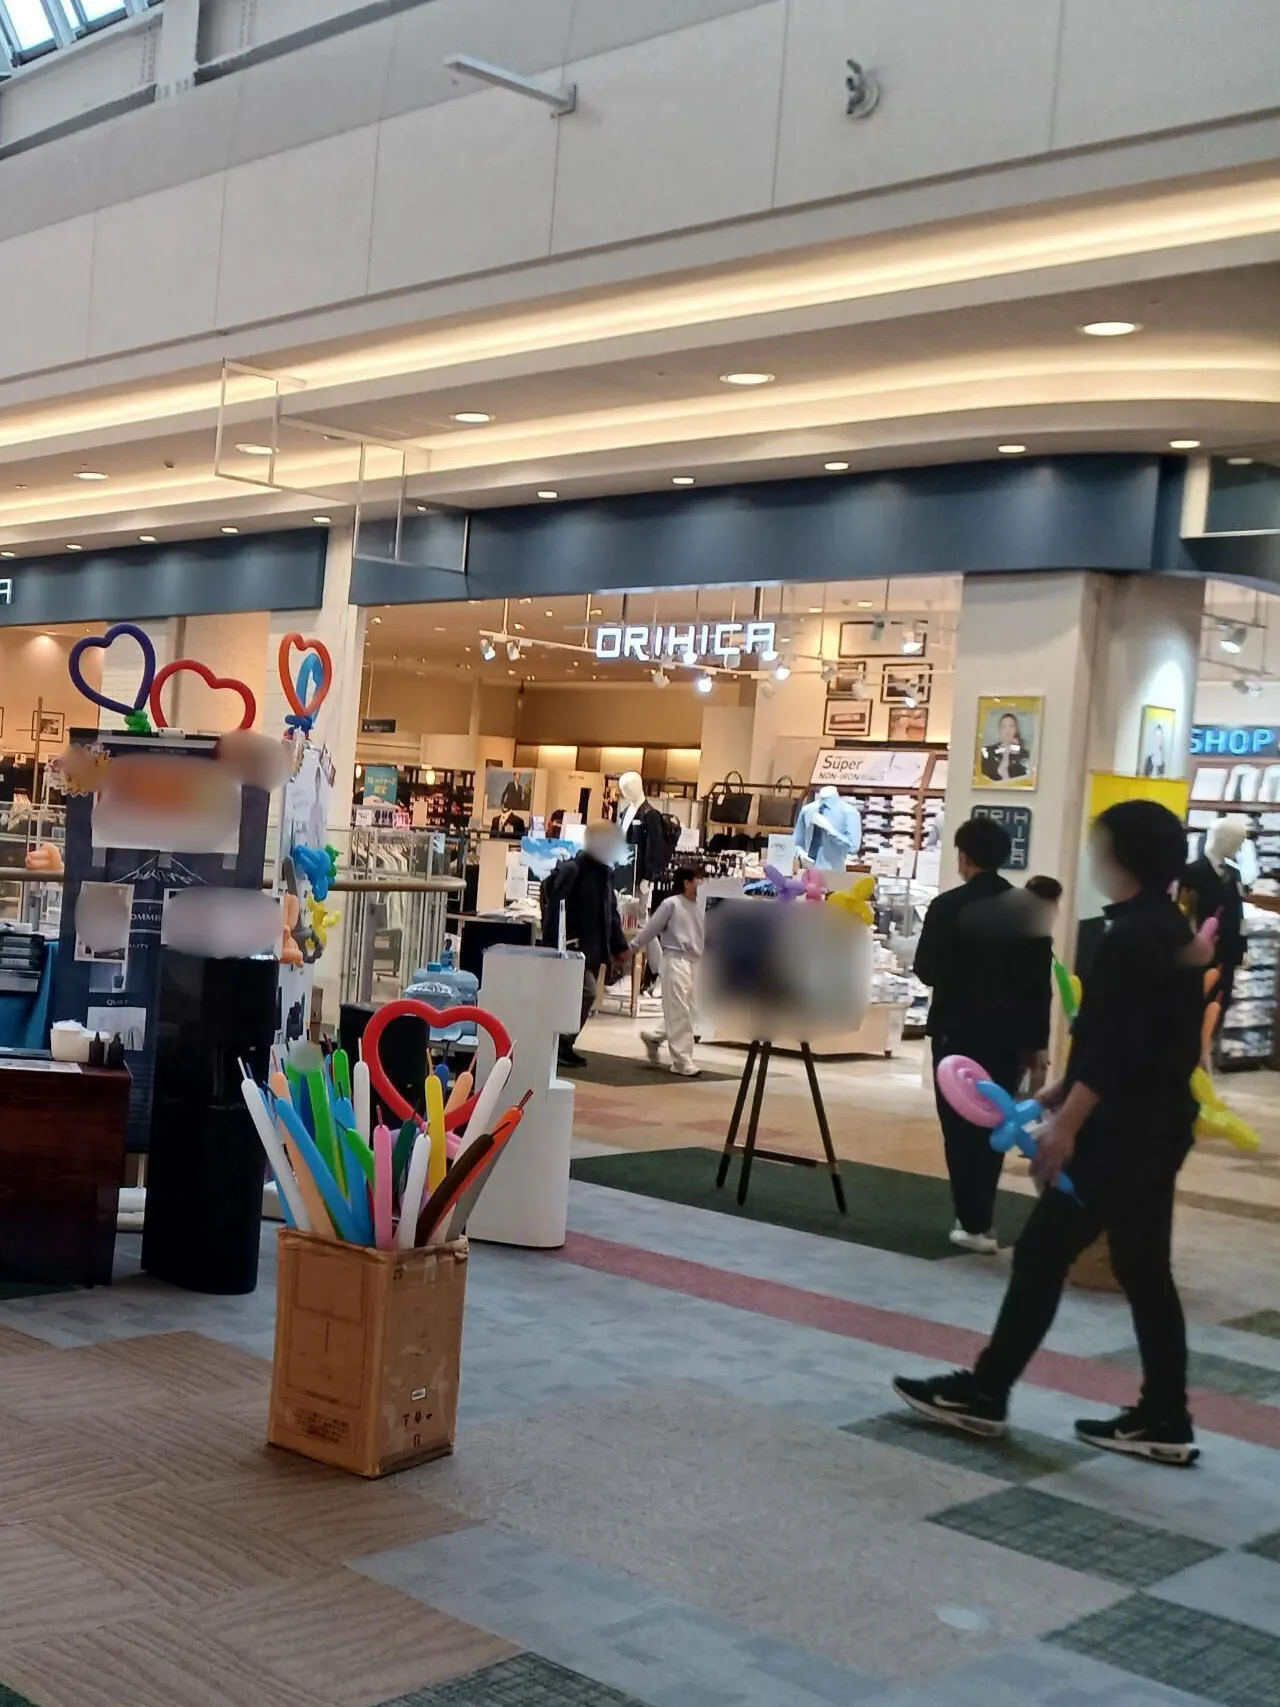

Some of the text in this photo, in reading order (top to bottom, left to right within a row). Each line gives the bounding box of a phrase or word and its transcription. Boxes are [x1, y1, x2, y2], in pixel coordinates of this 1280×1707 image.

[596, 622, 776, 662] ORIHICA
[1189, 728, 1274, 755] SHOP
[822, 755, 863, 772] Super
